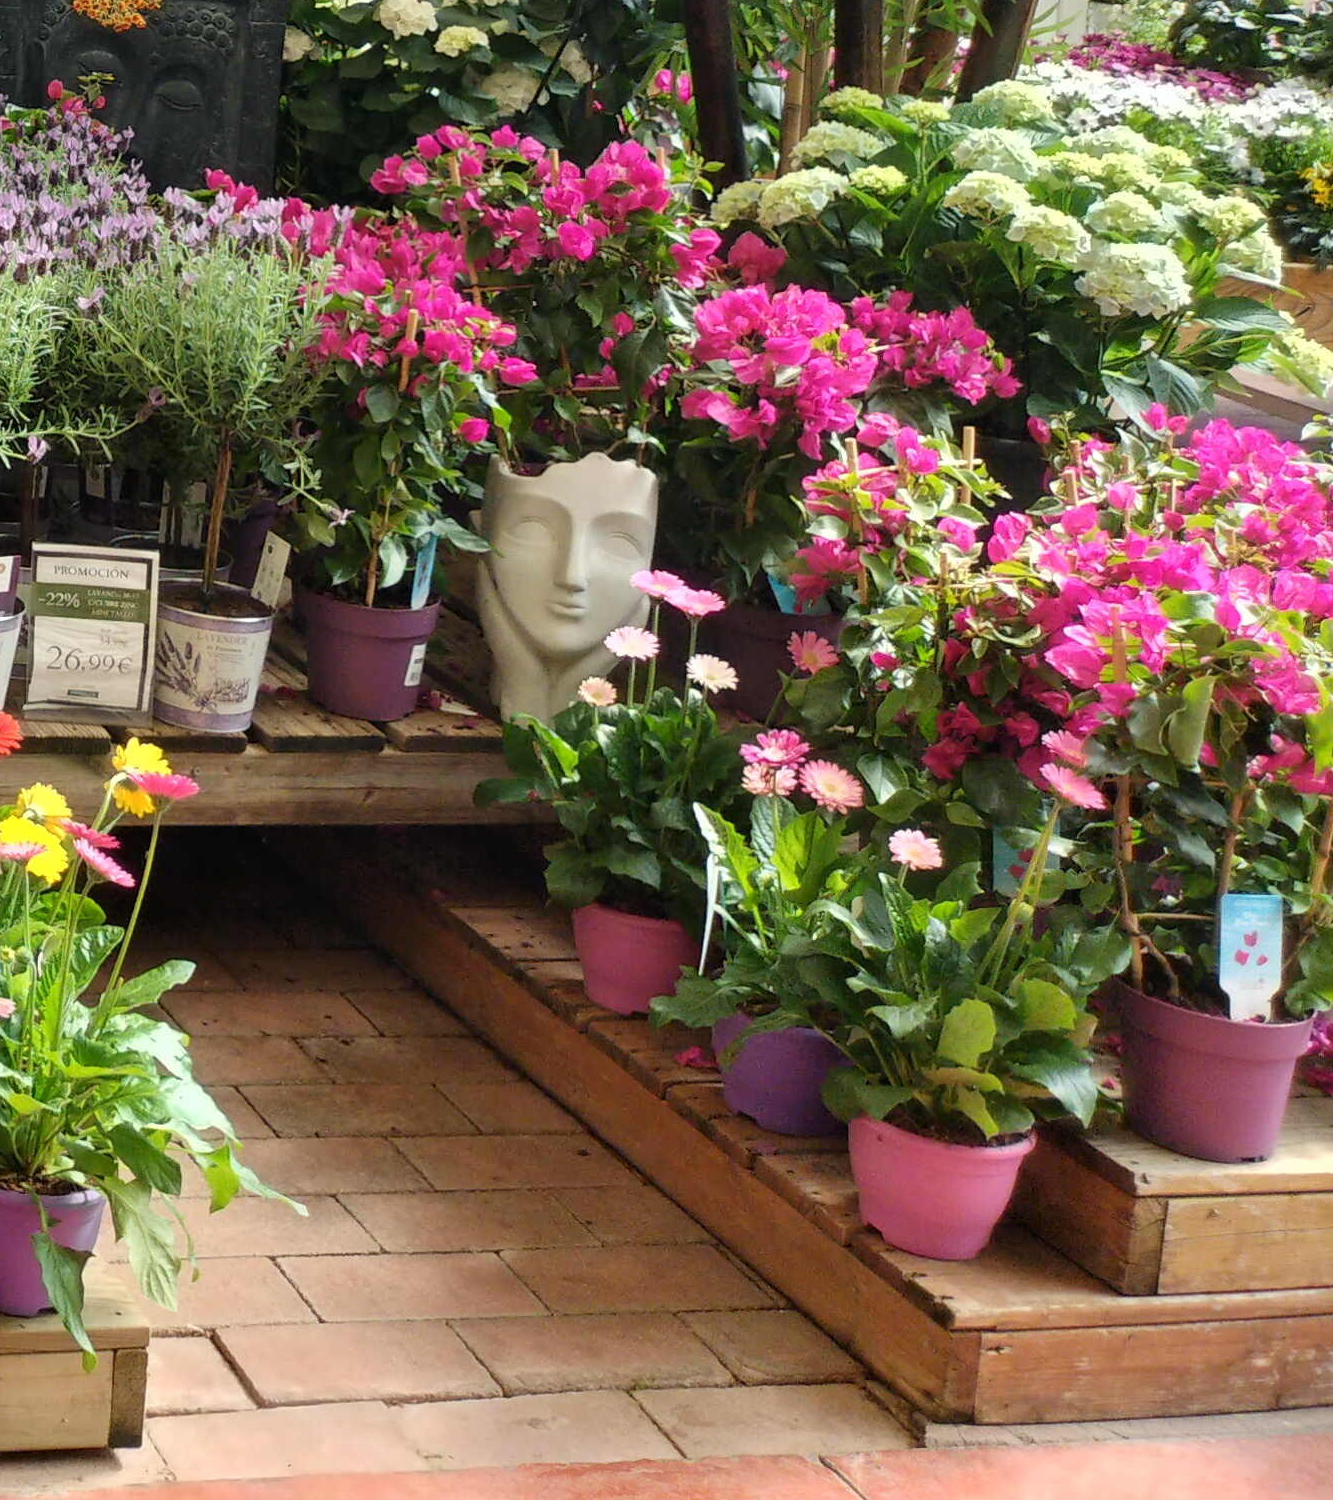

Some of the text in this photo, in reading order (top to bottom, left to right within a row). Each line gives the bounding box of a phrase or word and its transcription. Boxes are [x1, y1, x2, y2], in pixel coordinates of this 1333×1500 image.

[53, 565, 130, 579] PROMOCIÓN
[37, 591, 81, 609] -22%
[197, 631, 248, 644] LAVENDER
